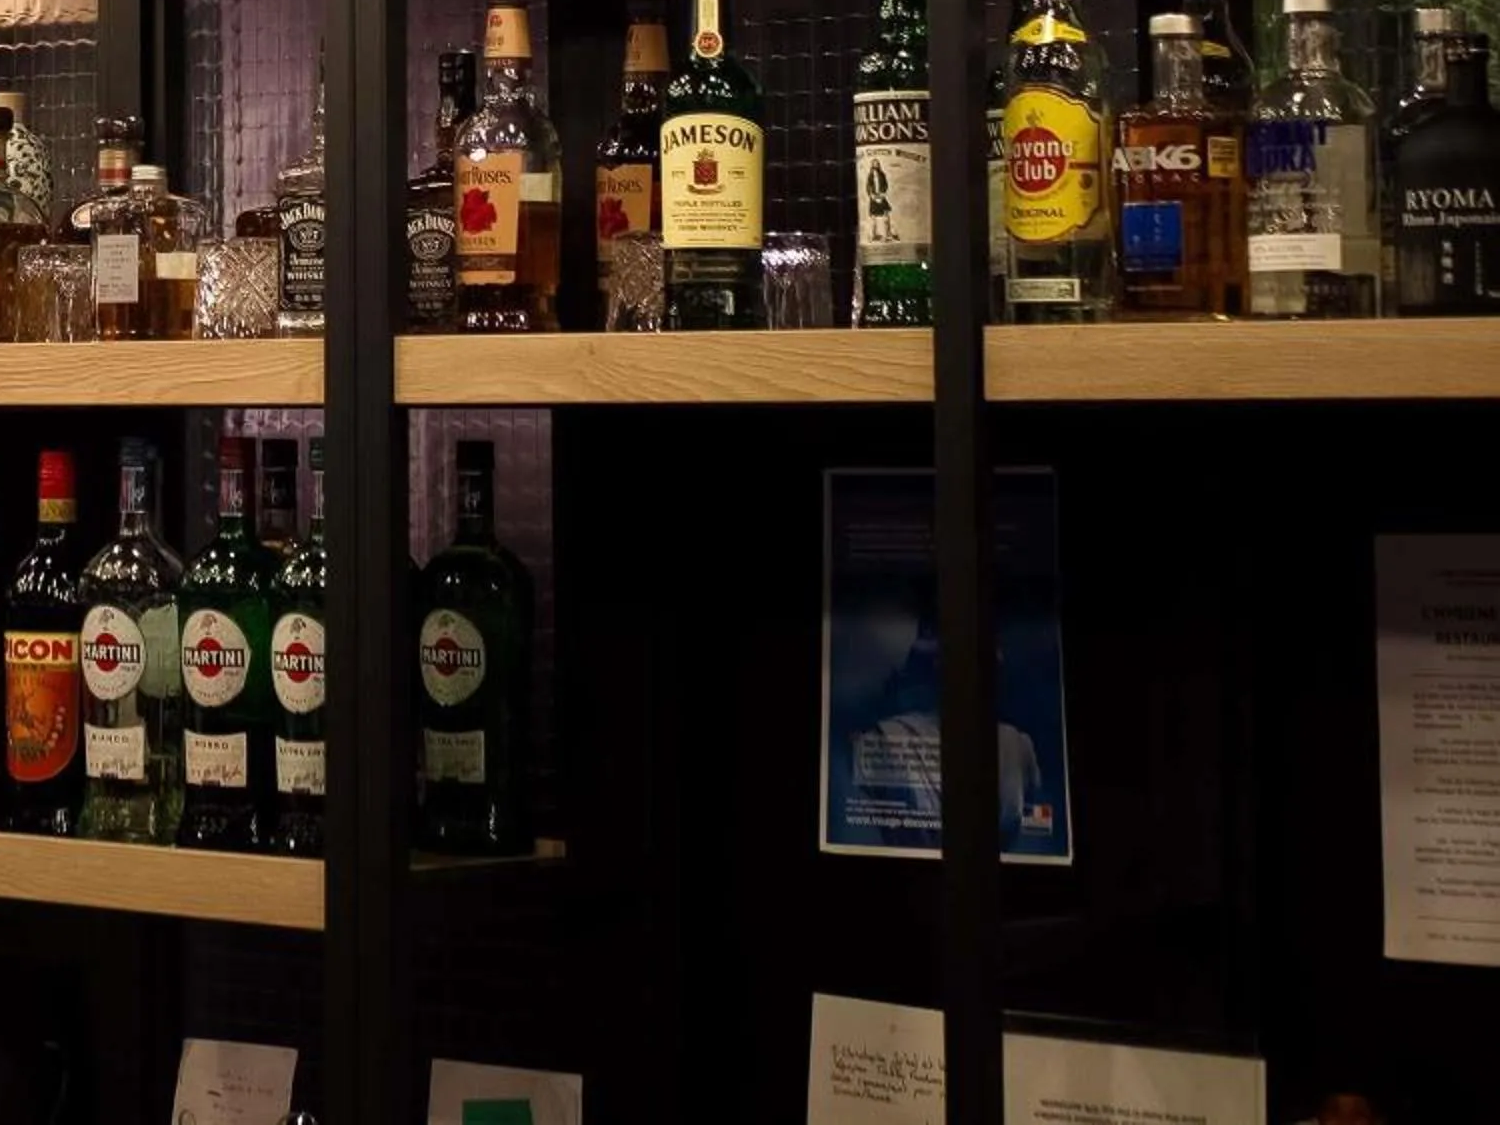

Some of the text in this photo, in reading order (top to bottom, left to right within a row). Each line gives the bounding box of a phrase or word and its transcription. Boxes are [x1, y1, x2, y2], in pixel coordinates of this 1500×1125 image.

[854, 103, 920, 124] ILLIAM
[663, 124, 756, 155] JAMESON
[1014, 159, 1057, 182] Club
[1405, 187, 1495, 210] RYOMA
[279, 205, 303, 231] JACK
[287, 270, 324, 280] WHISKE
[9, 638, 73, 661] ICON
[85, 643, 139, 661] MARTINI
[185, 648, 244, 667] MARTINI
[423, 647, 481, 668] MARTINI
[275, 654, 324, 672] MARTIN
